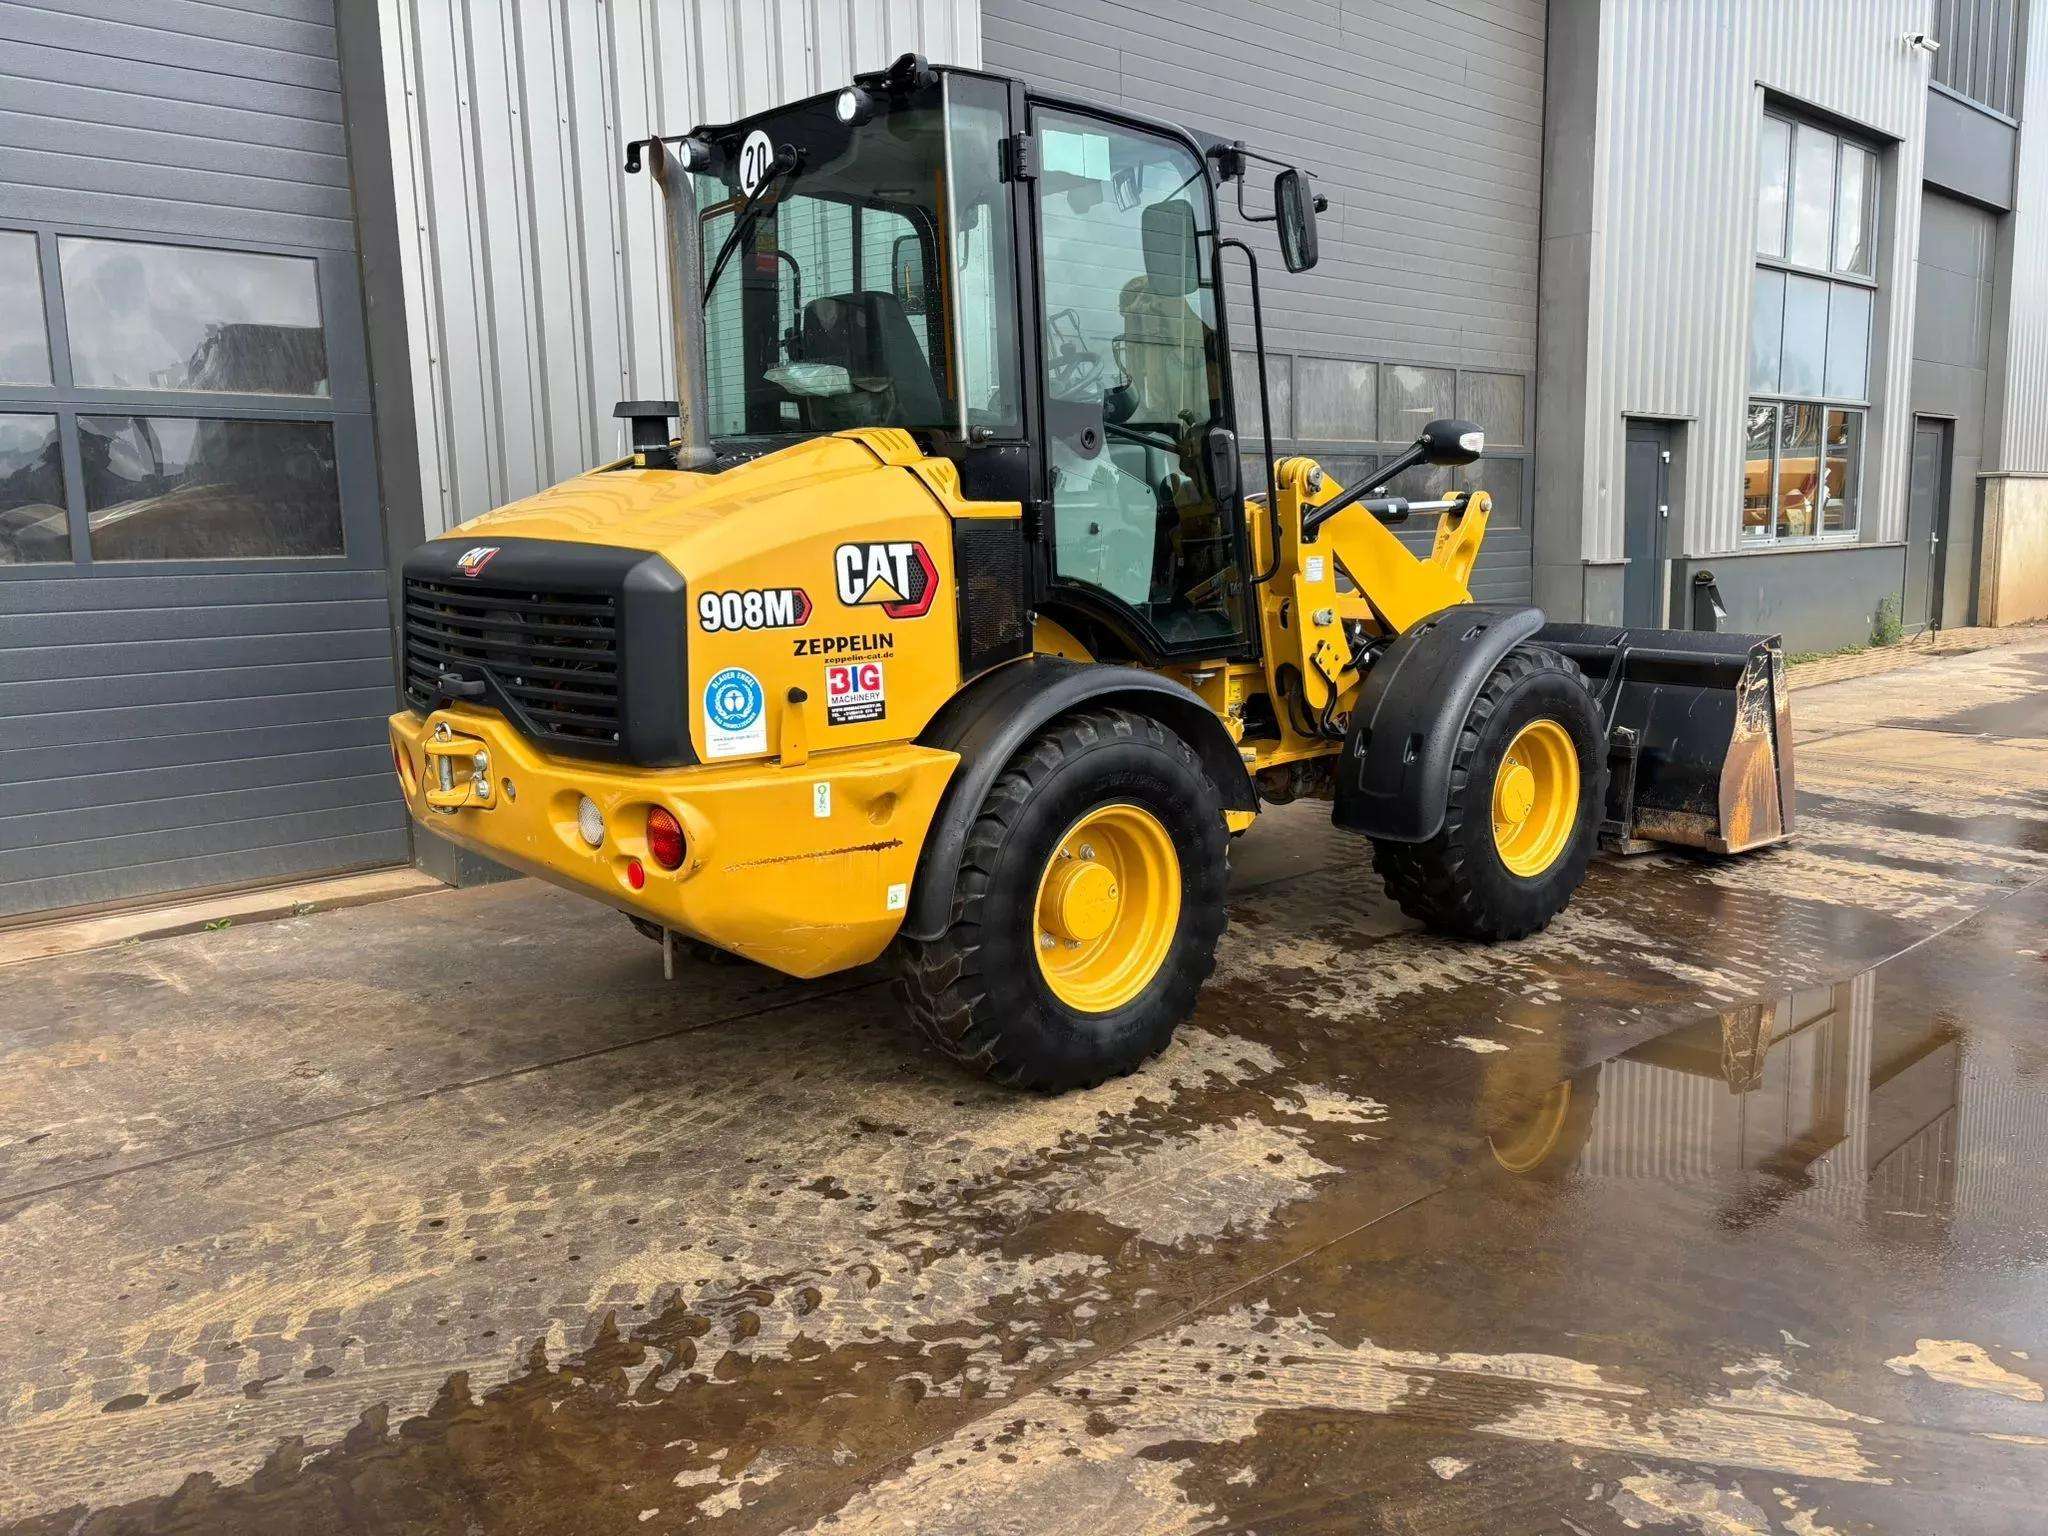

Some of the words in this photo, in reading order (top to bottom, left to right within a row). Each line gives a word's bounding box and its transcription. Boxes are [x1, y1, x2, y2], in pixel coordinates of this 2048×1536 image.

[746, 142, 767, 188] 20
[458, 547, 498, 566] CAT
[836, 543, 913, 604] CAT
[699, 590, 795, 630] 908M
[793, 632, 894, 656] ZEPPELIN
[825, 651, 894, 664] zeppelin-cat.de
[711, 672, 735, 689] BLAUER
[737, 672, 756, 687] ENGEL
[831, 692, 880, 704] MACHINERY
